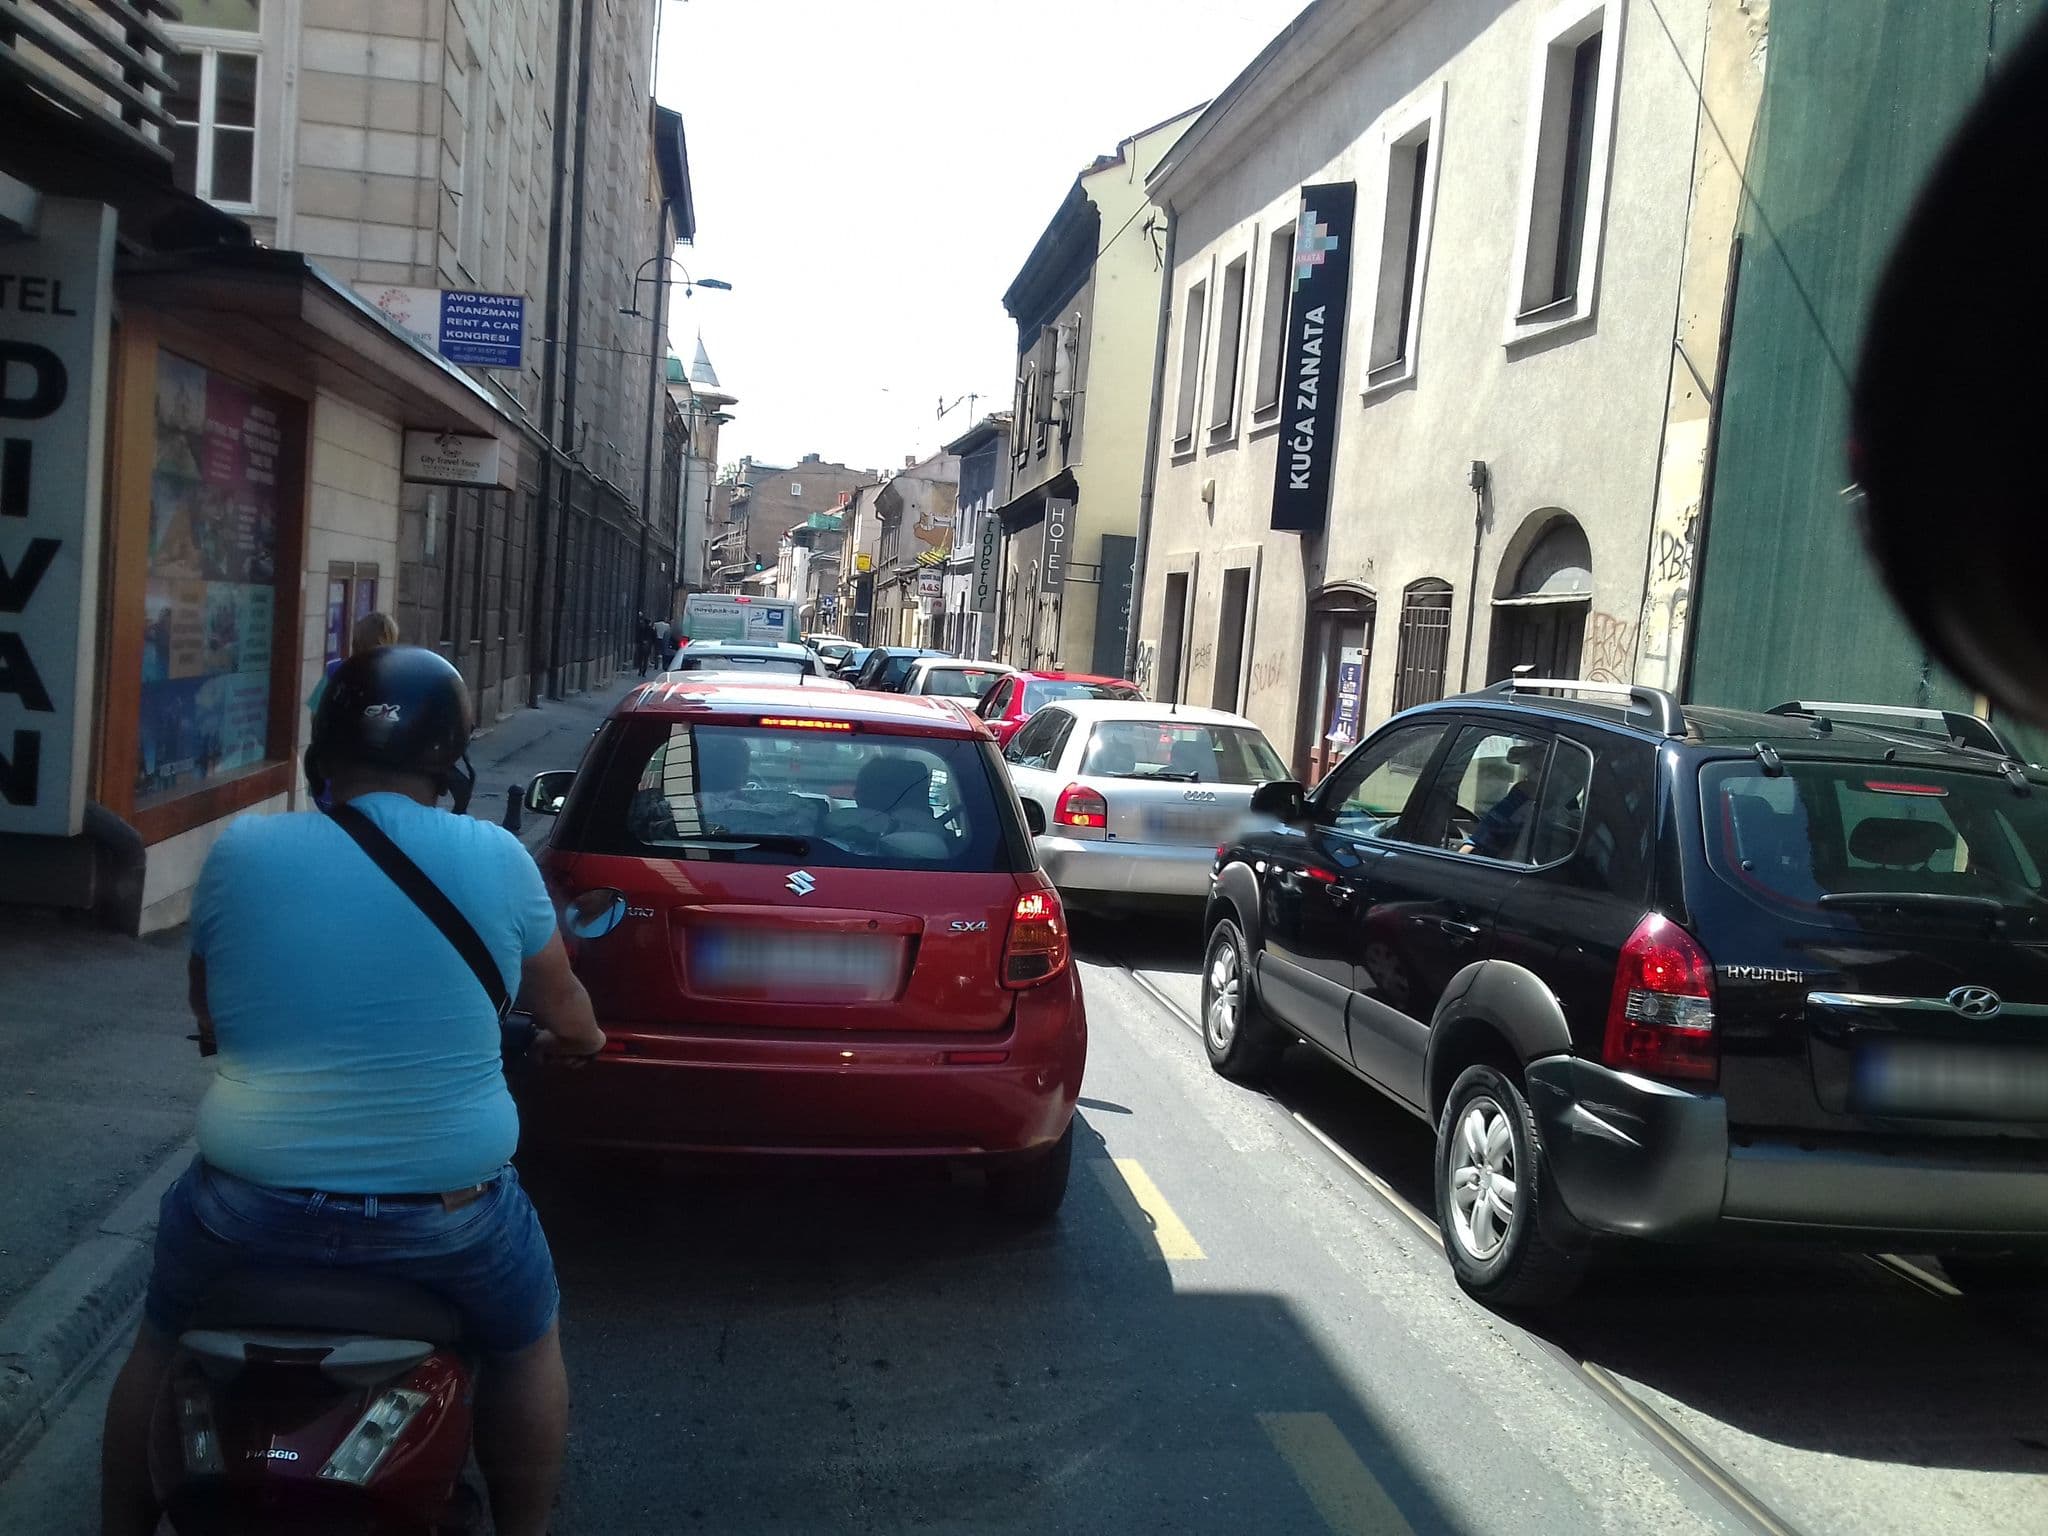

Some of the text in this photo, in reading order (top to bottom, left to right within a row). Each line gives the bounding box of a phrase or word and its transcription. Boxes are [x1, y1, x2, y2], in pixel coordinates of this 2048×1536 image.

[447, 293, 520, 307] AVIO KARTE
[447, 304, 519, 319] ARANŽMANI
[446, 317, 519, 331] RENT A CAR
[446, 329, 510, 343] KONGRESI
[1287, 304, 1326, 490] KUĆA ZANATA
[420, 455, 434, 465] City
[437, 456, 460, 466] Travel
[1047, 507, 1065, 585] HOTEL
[977, 520, 994, 609] tapetar
[920, 582, 940, 592] A&S
[948, 919, 988, 932] SX4
[1727, 964, 1804, 984] HYUNDAI
